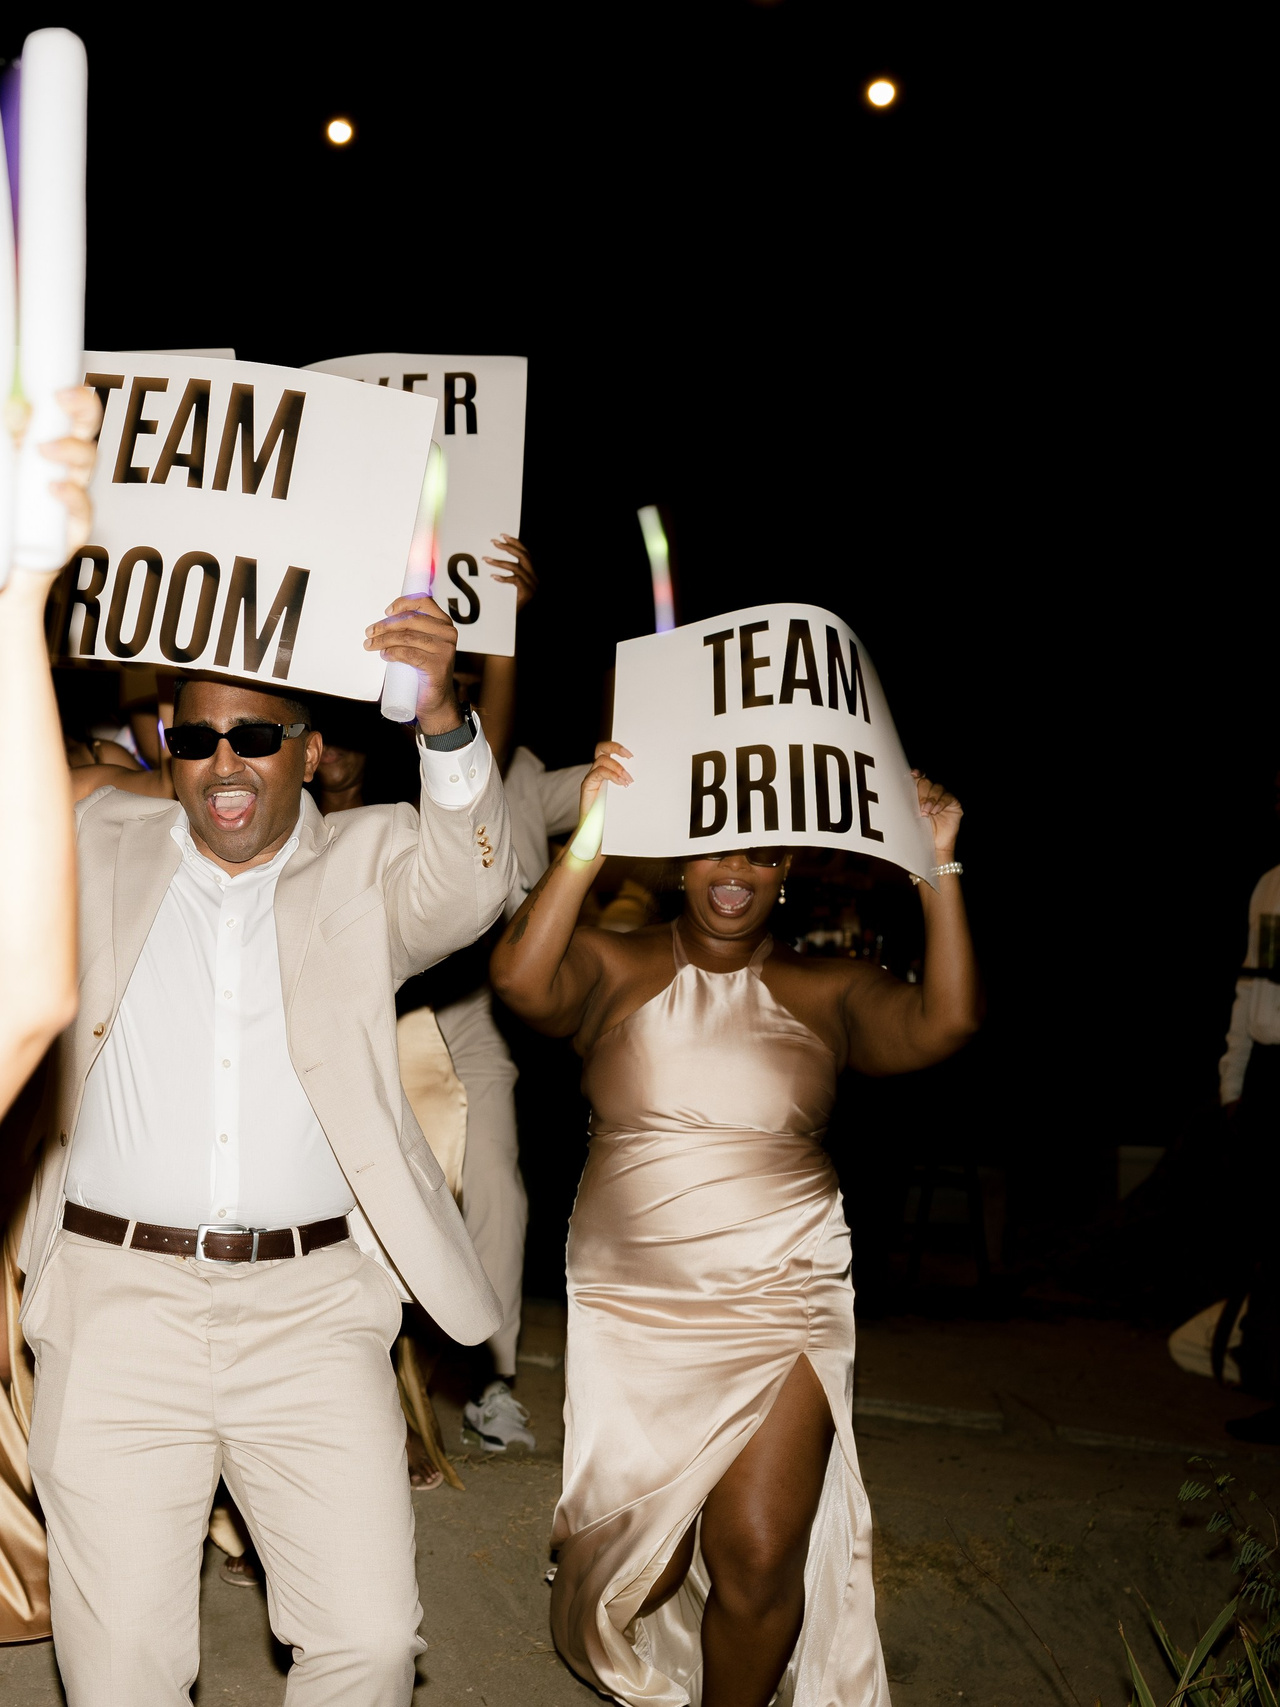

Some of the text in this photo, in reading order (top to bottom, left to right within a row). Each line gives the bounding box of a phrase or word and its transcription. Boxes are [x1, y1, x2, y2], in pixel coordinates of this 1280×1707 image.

[74, 372, 307, 500] TEAM
[57, 544, 311, 681] ROOM
[703, 618, 871, 725] TEAM
[688, 743, 884, 843] BRIDE
